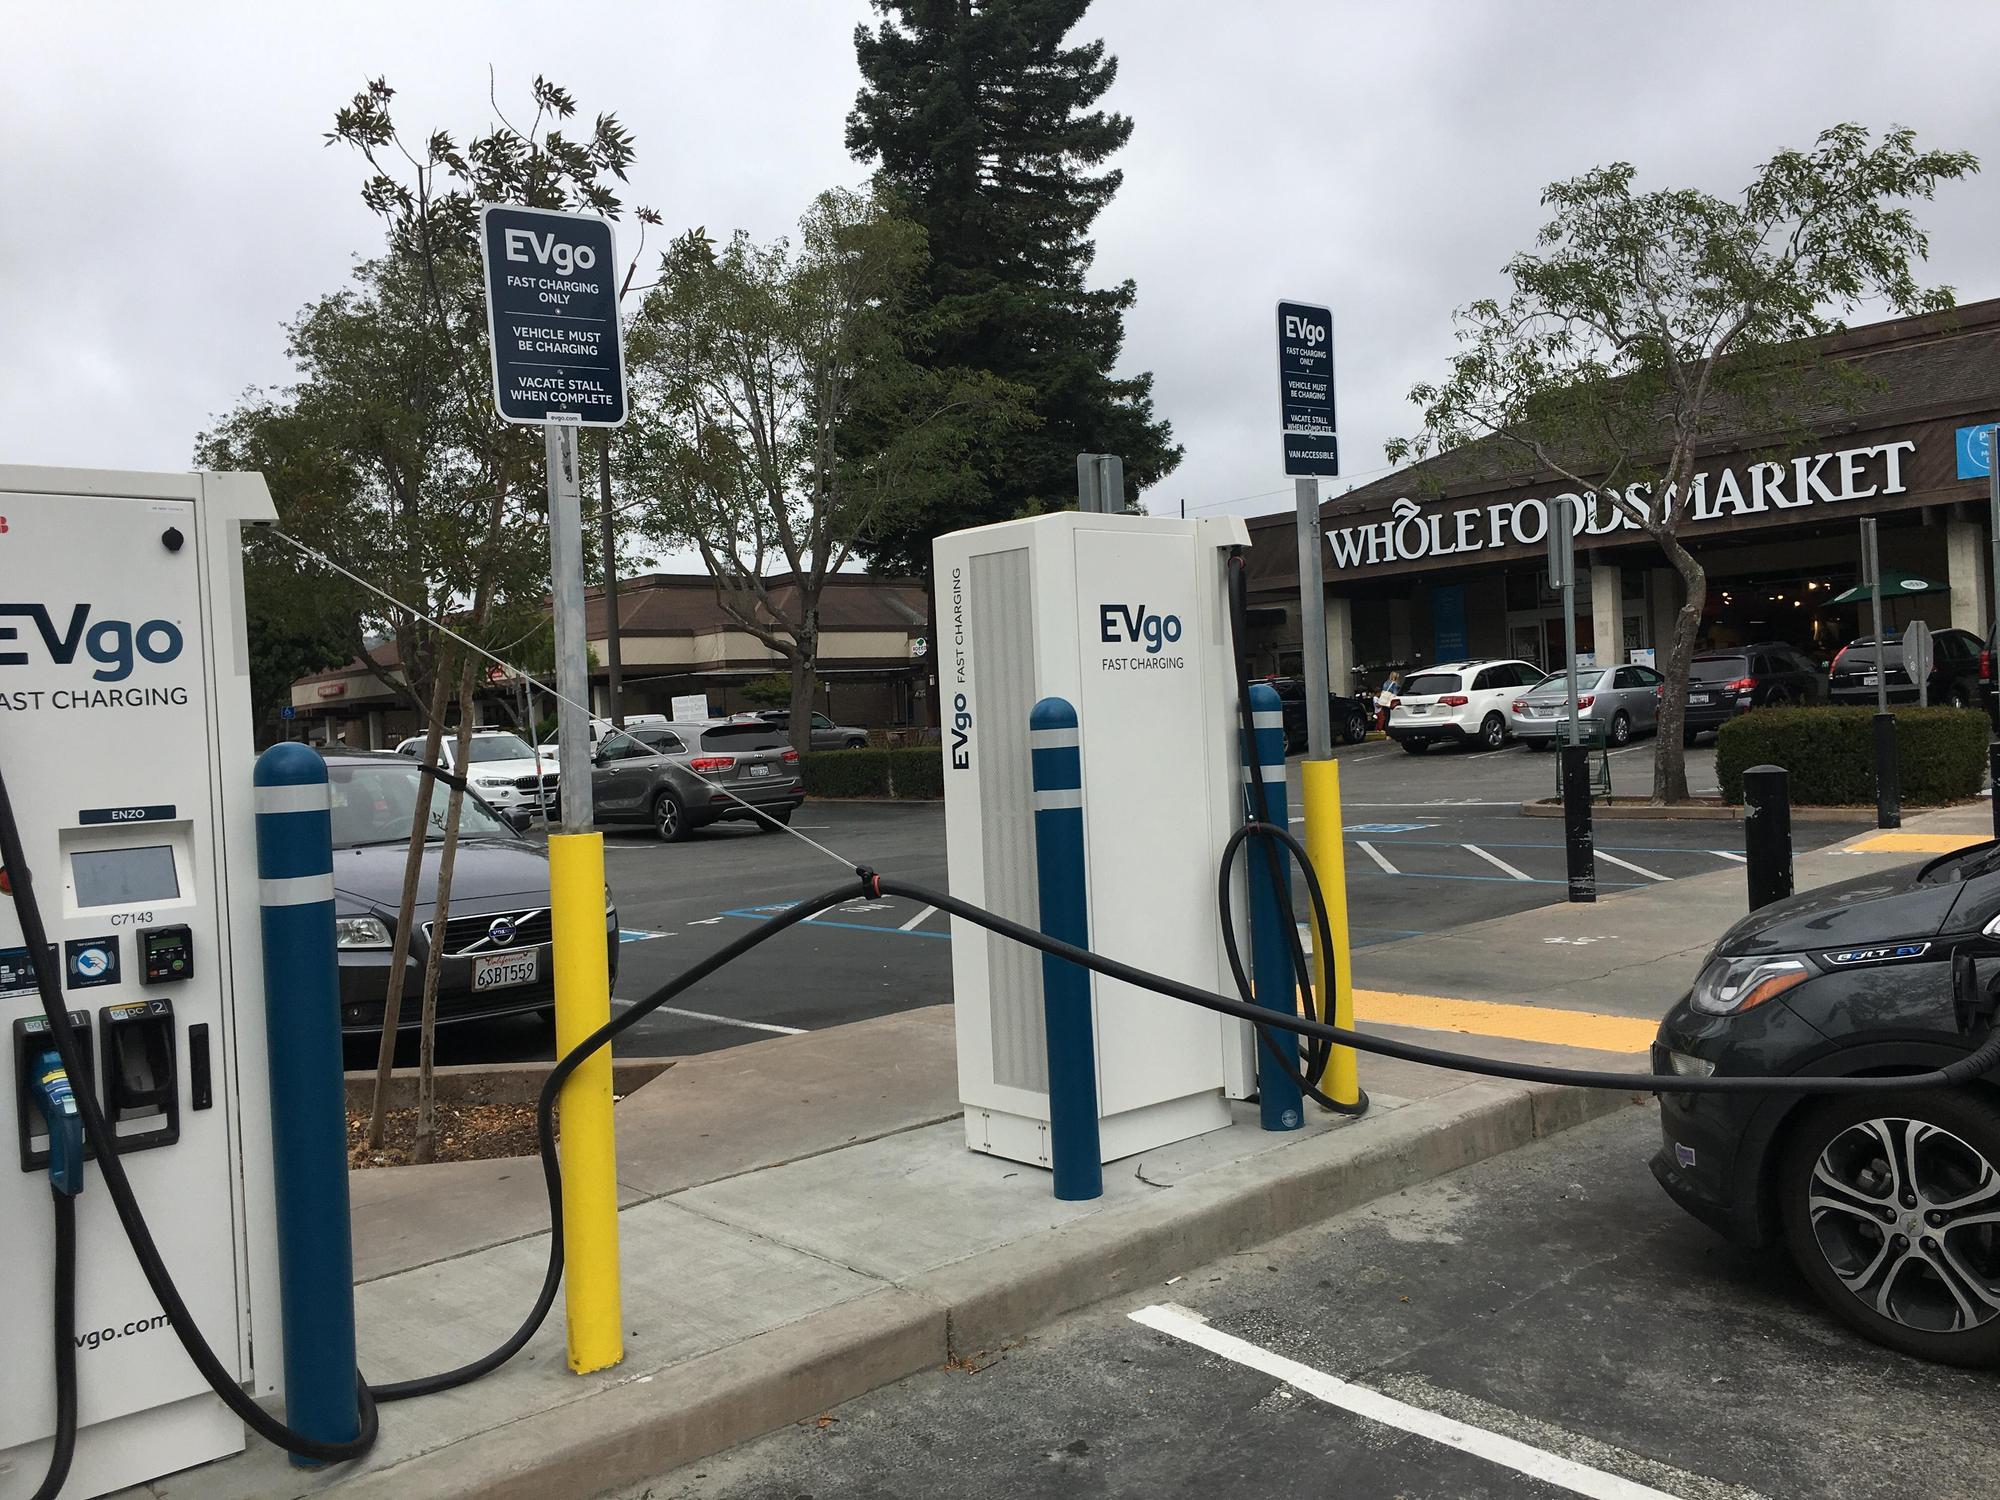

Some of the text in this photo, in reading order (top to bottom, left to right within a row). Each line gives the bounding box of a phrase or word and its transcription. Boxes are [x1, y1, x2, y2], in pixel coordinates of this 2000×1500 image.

[505, 228, 596, 276] EVgo
[507, 276, 599, 294] FAST CHARGING
[539, 292, 571, 305] ONLY
[512, 326, 601, 343] VEHICLE MUST
[1286, 316, 1325, 347] EVgo
[518, 340, 598, 356] BE CHARGING
[1286, 346, 1327, 359] FAST CHARGING
[1299, 357, 1315, 366] ONLY
[518, 376, 604, 392] VACATE STALL
[1288, 381, 1328, 392] VEHICLE MUST
[510, 389, 613, 405] WHEN COMPLETE
[1290, 390, 1326, 401] BE CHARGING
[550, 414, 579, 423] evgo.com
[1290, 414, 1328, 425] VACATE STALL
[1287, 423, 1332, 433] WHEN COMPLETE
[1288, 450, 1335, 460] VAN ACCESSIBLE
[1326, 498, 1484, 569] WHOLE
[1661, 440, 1917, 521] MARKET
[1100, 604, 1182, 654] EVgo
[951, 568, 972, 770] EVgo FAST CHARGING
[1102, 657, 1184, 671] FAST CHARGING
[0, 687, 188, 711] AST CHARGING
[111, 809, 145, 820] ENZO
[110, 912, 153, 926] C7143
[1837, 946, 1921, 961] BOLT EV
[477, 962, 534, 986] 6SBT559
[128, 1007, 144, 1016] DC
[152, 1001, 166, 1014] 2
[71, 1013, 80, 1025] 1
[74, 1314, 172, 1350] vgo.com
